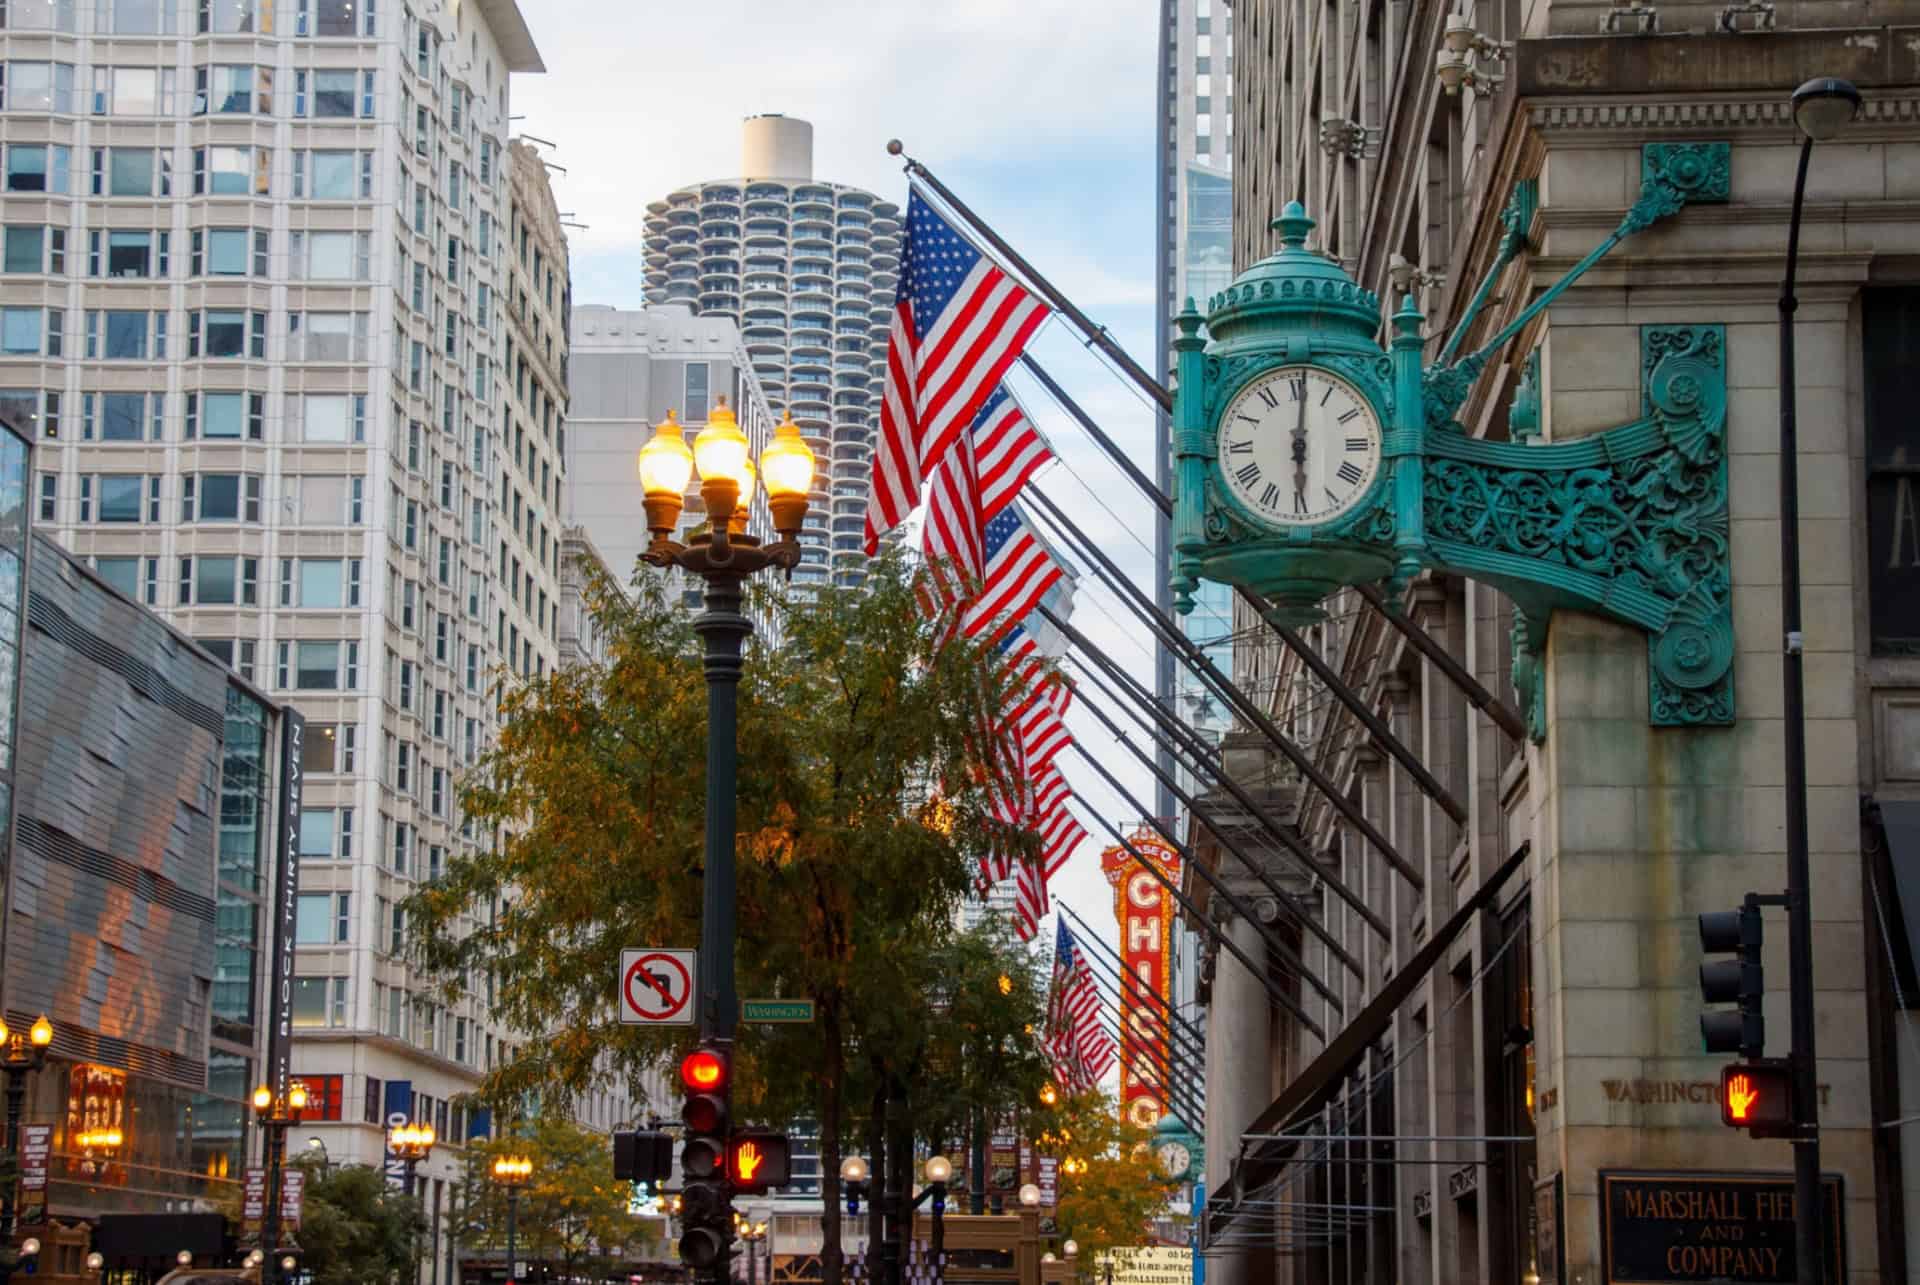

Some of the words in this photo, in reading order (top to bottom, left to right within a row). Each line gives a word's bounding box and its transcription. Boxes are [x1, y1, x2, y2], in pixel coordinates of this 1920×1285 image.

[1345, 438, 1368, 452] III
[290, 723, 301, 816] SEVEN
[1116, 845, 1160, 861] CASE
[285, 825, 298, 925] THIRTY
[280, 936, 293, 1036] BLOCK
[1600, 1080, 1722, 1104] WASHINGT
[1623, 1189, 1746, 1221] MARSHALL
[1752, 1191, 1799, 1222] FIE
[1698, 1225, 1744, 1241] AND
[1666, 1246, 1782, 1276] COMPANY
